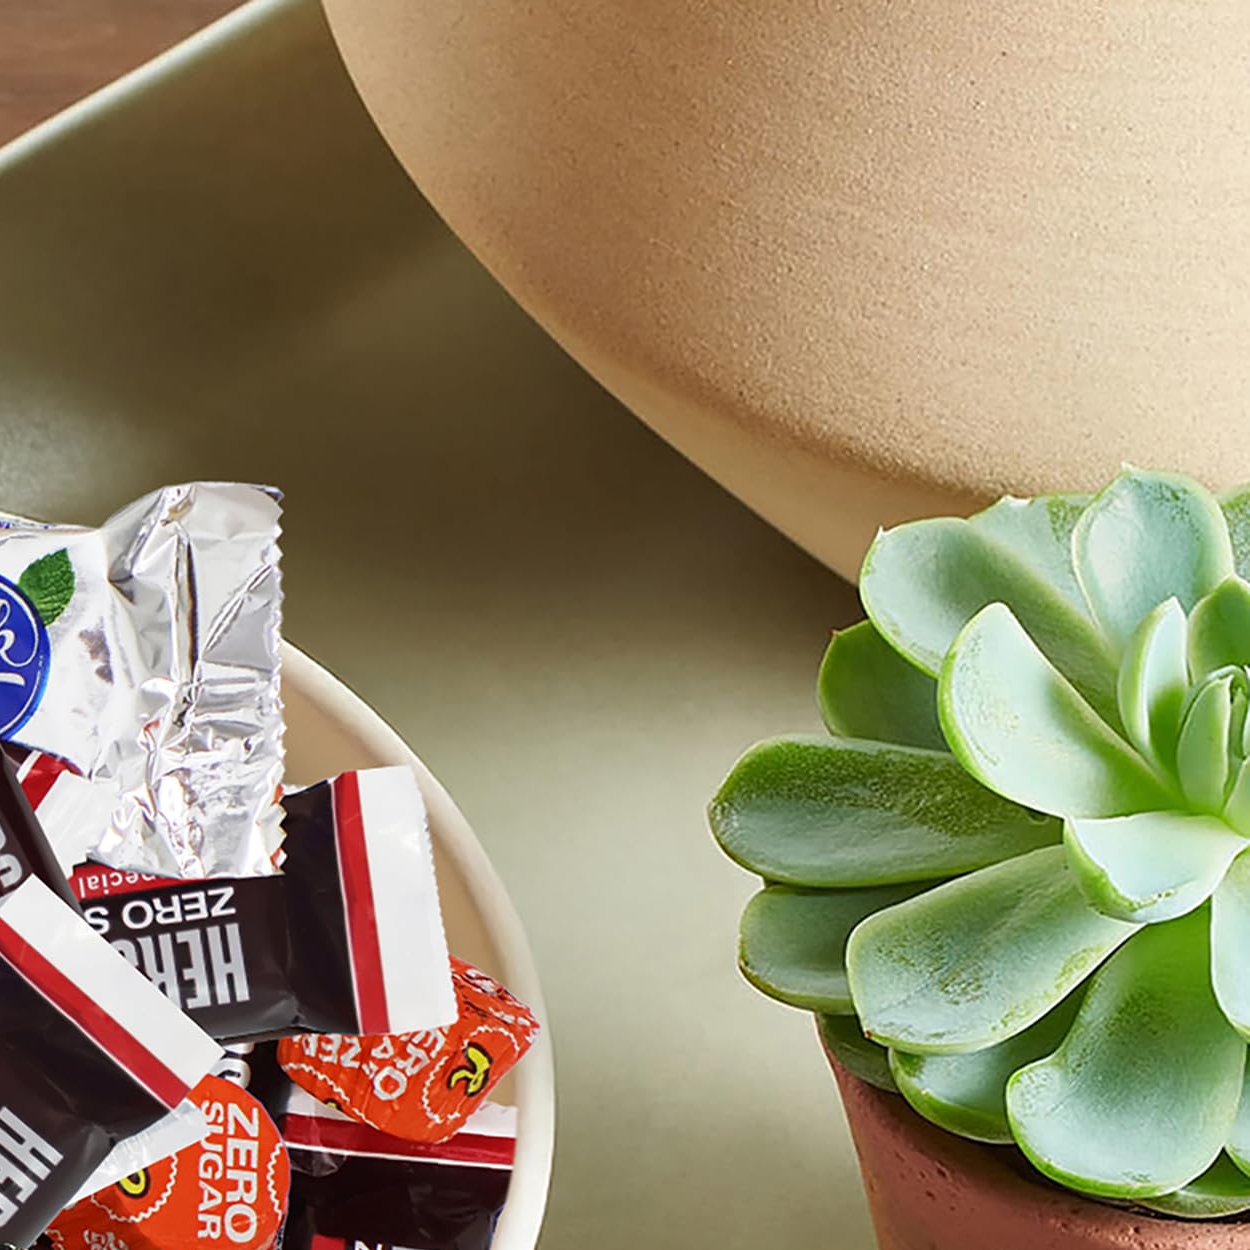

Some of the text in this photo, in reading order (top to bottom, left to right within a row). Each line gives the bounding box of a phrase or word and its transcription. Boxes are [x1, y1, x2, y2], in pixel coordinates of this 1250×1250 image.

[122, 886, 237, 930] ZERO
[374, 1027, 449, 1101] ERO
[197, 1100, 225, 1240] SUGAR
[224, 1102, 260, 1244] ZERO
